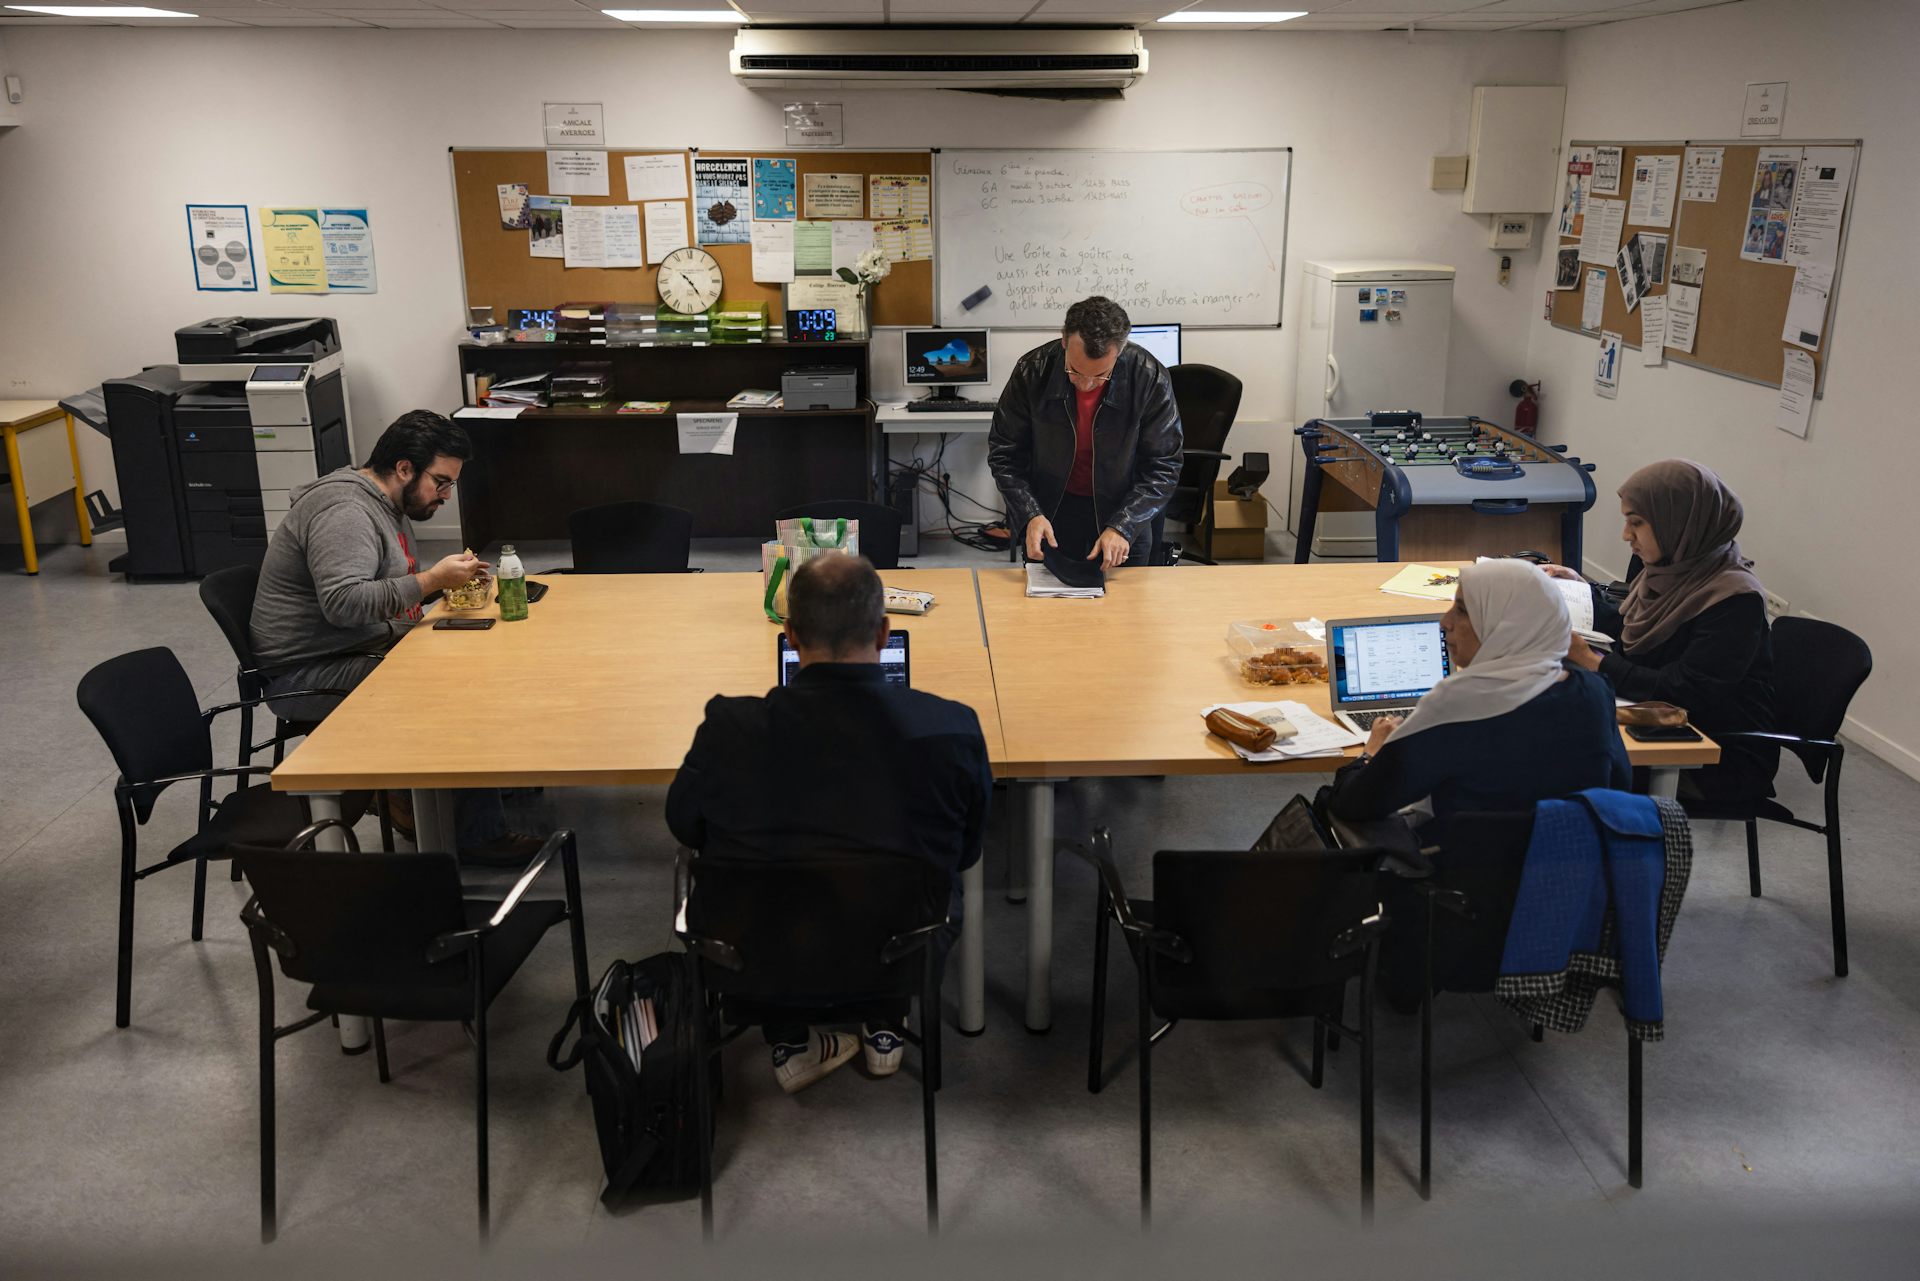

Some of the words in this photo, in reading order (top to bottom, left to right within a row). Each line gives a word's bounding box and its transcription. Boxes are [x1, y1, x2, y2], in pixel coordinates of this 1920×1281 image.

[696, 162, 747, 172] HARCELEMENT
[736, 173, 747, 181] PAS
[982, 180, 998, 194] 6A
[982, 197, 998, 210] 6C
[994, 246, 1014, 264] Une
[1060, 247, 1068, 258] à
[1122, 251, 1133, 260] a
[996, 268, 1028, 280] aussi
[1034, 263, 1050, 276] été
[1058, 266, 1082, 276] mise
[1092, 263, 1100, 274] à
[1106, 264, 1134, 276] votre
[1006, 281, 1062, 298] disposition
[1134, 280, 1150, 294] est
[1156, 290, 1187, 306] choses
[1192, 292, 1199, 304] à
[1202, 294, 1243, 312] manger
[799, 310, 835, 330] 0:09
[824, 331, 834, 341] 23
[909, 366, 926, 374] 12:49
